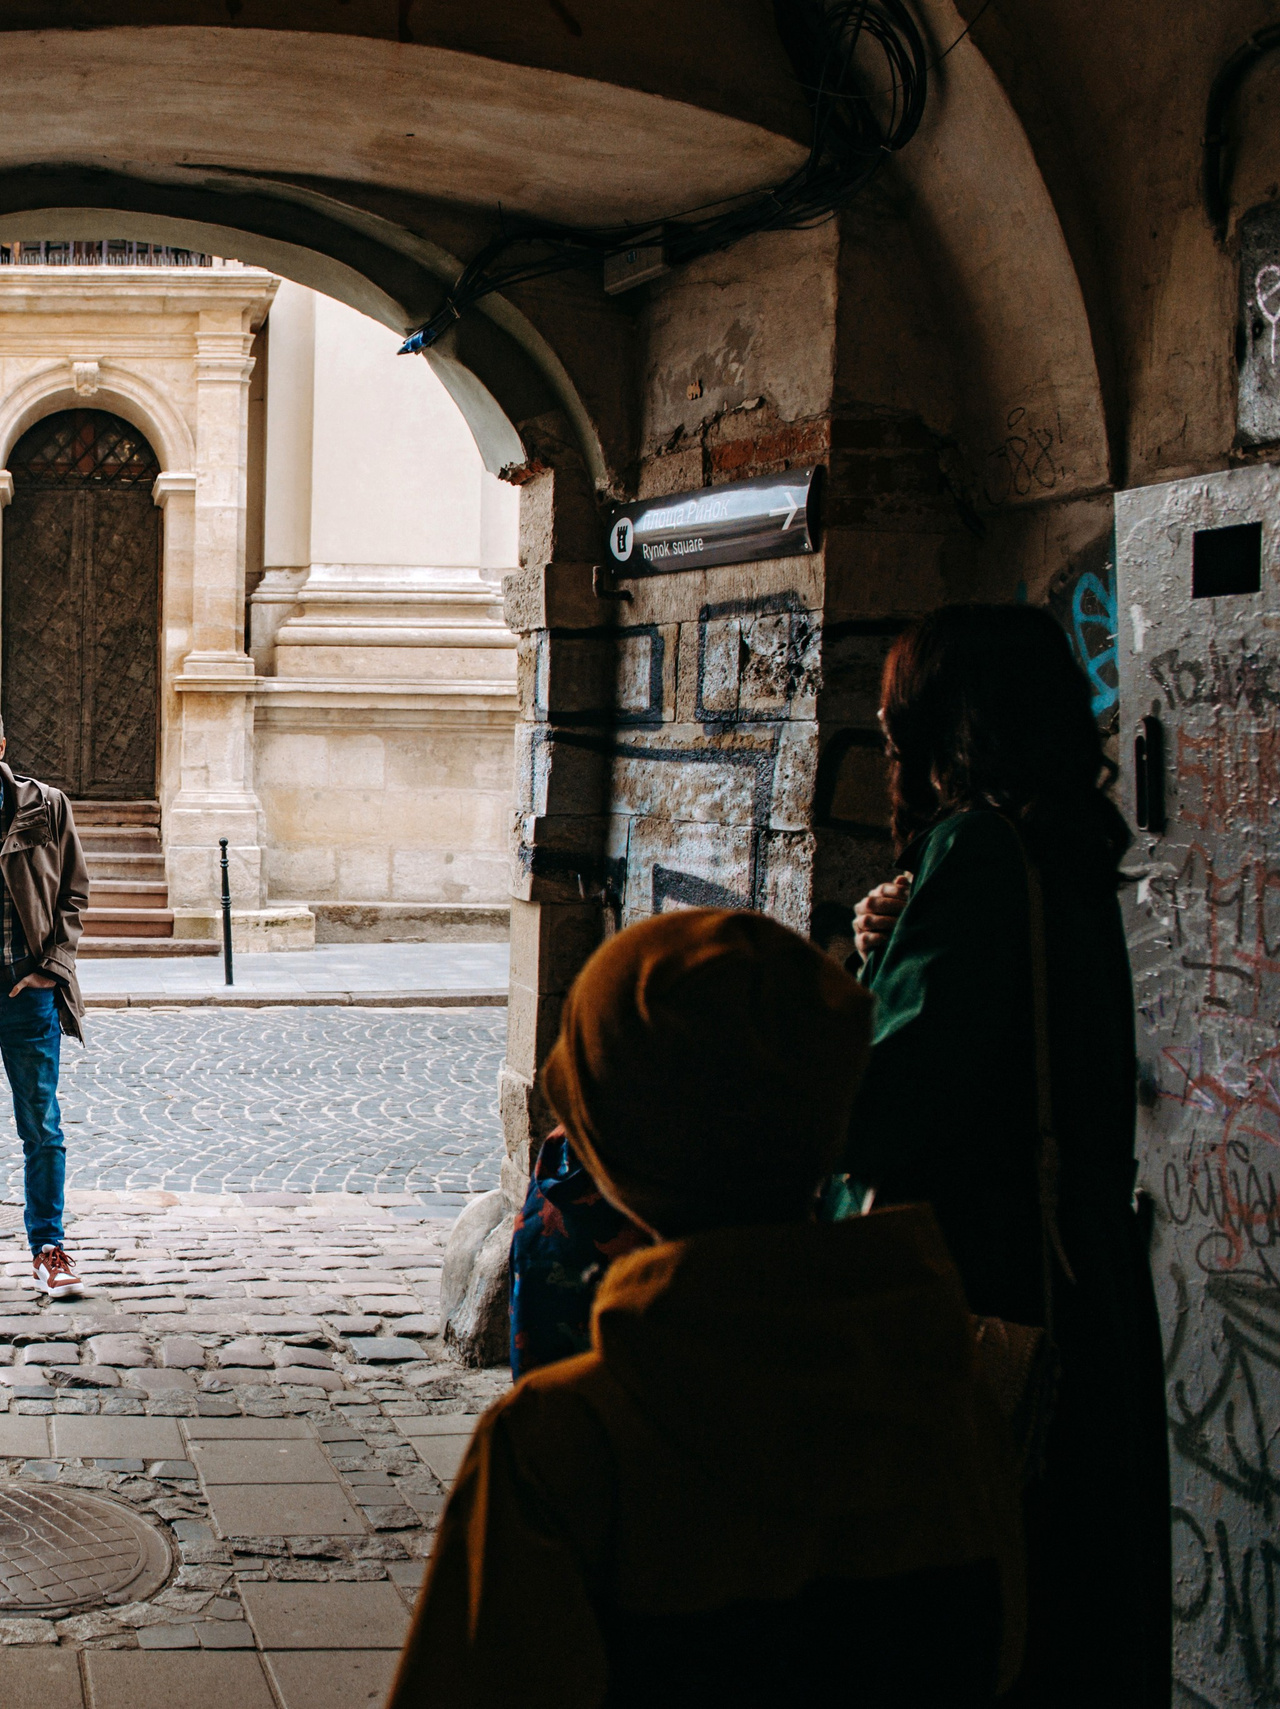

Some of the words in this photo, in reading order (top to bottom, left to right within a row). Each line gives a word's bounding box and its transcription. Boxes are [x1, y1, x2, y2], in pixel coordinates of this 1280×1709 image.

[642, 508, 684, 531] площа
[687, 498, 729, 521] Ринок
[643, 540, 670, 562] Rynok
[673, 537, 704, 556] square
